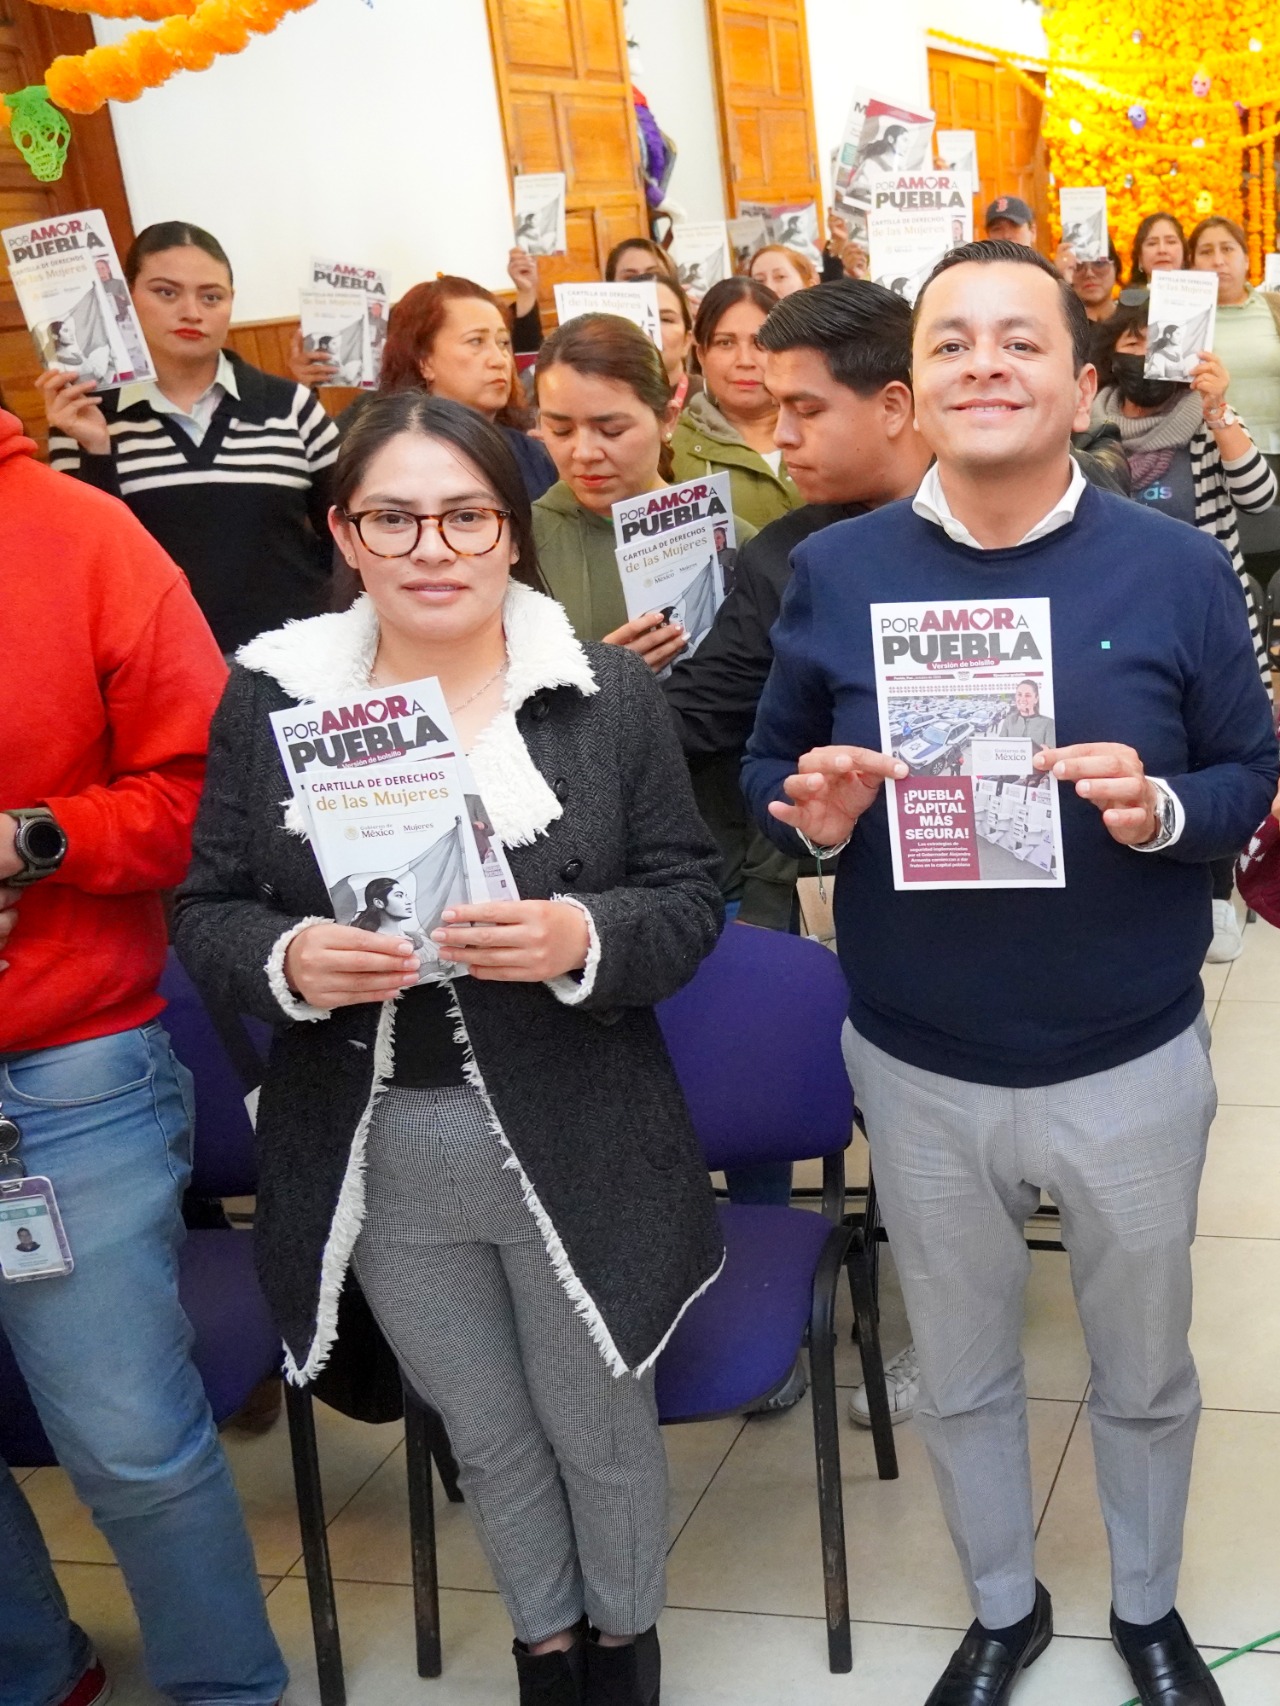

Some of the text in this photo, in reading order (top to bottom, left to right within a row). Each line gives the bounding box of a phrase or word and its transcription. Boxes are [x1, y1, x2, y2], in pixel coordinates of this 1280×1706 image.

[876, 182, 895, 191] POR
[896, 176, 950, 190] AMOR
[875, 191, 965, 209] PUEBLA
[9, 220, 92, 249] POR AMOR A
[12, 232, 105, 263] PUEBLA
[313, 270, 386, 295] PUEBLA
[620, 484, 718, 524] POR AMOR A
[621, 496, 727, 544] PUEBLA
[623, 526, 706, 562] CARTILLA DE DERECHOS
[625, 561, 640, 574] de
[643, 554, 660, 568] las
[662, 536, 708, 560] Mujeres
[654, 572, 675, 585] México
[880, 607, 1029, 633] POR AMOR A
[882, 631, 1043, 665] PUEBLA
[931, 661, 959, 670] Versión
[969, 659, 995, 667] bolsillo
[283, 694, 426, 743] POR AMOR A
[288, 714, 449, 774] PUEBLA
[367, 756, 377, 764] de
[377, 750, 402, 760] bolsillo
[995, 752, 1027, 761] México
[311, 771, 445, 793] CARTILLA DE DERECHOS
[316, 785, 449, 812] de las Mujeres
[903, 789, 965, 804] ¡PUEBLA
[903, 802, 967, 815] CAPITAL
[919, 811, 954, 827] MÁS
[361, 828, 395, 839] México
[402, 822, 435, 832] Mujeres
[905, 827, 970, 840] SEGURA!
